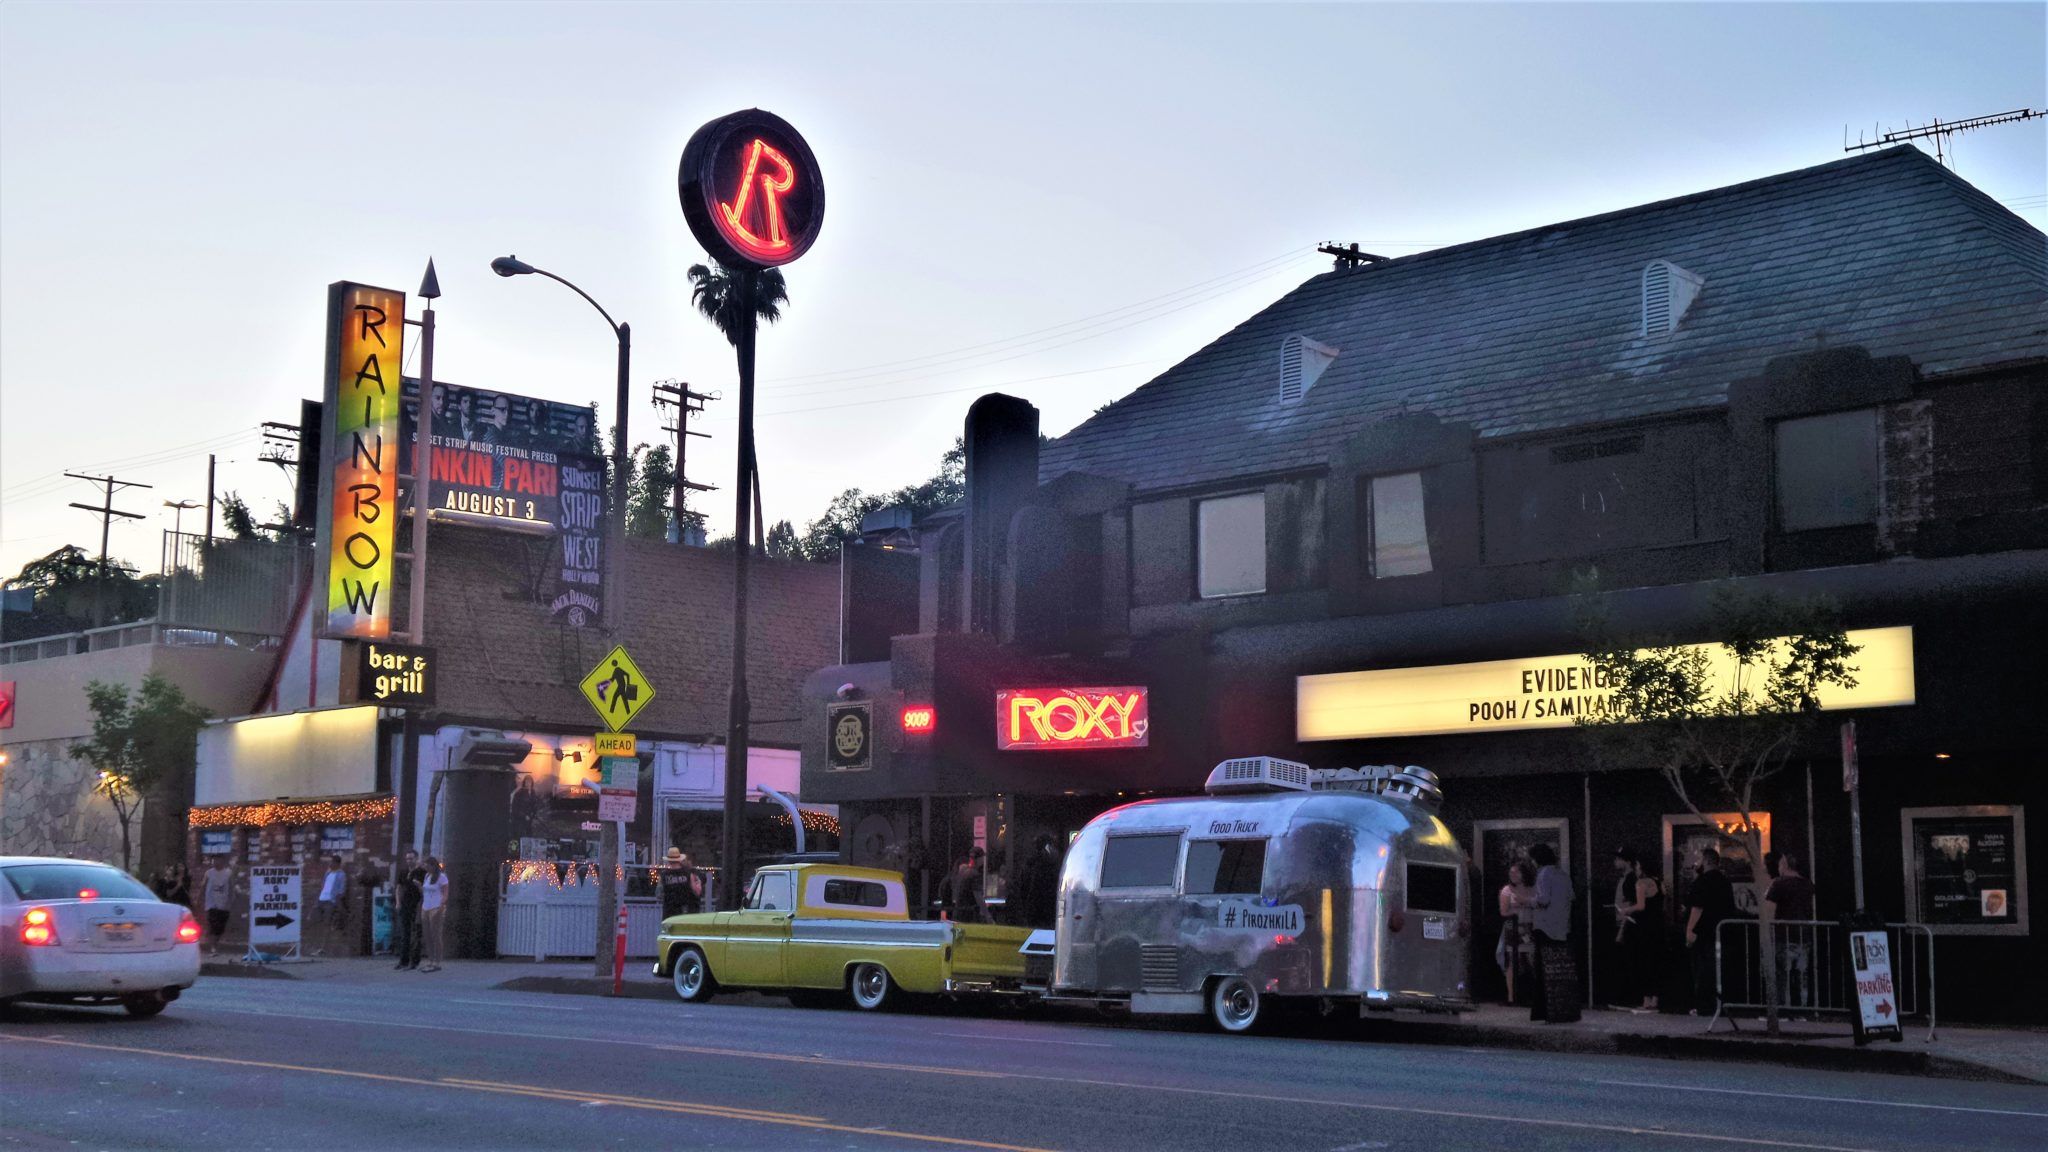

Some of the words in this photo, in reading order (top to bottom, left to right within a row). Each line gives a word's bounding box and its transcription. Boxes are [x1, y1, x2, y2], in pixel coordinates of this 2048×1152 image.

[412, 432, 442, 446] SSET
[445, 437, 467, 449] STRIP
[470, 441, 493, 454] MUSIC
[495, 445, 529, 459] FESTIVAL
[341, 304, 386, 617] RAINBOW
[445, 490, 516, 517] AUGUST
[525, 501, 534, 520] 3
[561, 490, 601, 529] STRIP
[562, 534, 600, 569] WEST
[551, 593, 570, 615] JACK
[368, 644, 408, 670] bar
[413, 656, 427, 672] &
[374, 671, 423, 699] grill
[904, 711, 931, 727] 9009
[1011, 693, 1139, 741] ROXY
[1469, 700, 1517, 721] POOH
[599, 739, 632, 751] AHEAD
[1209, 820, 1232, 834] FOOD
[1232, 819, 1259, 833] TRUCK
[253, 901, 298, 911] PARKING
[1858, 980, 1892, 995] PARKING
